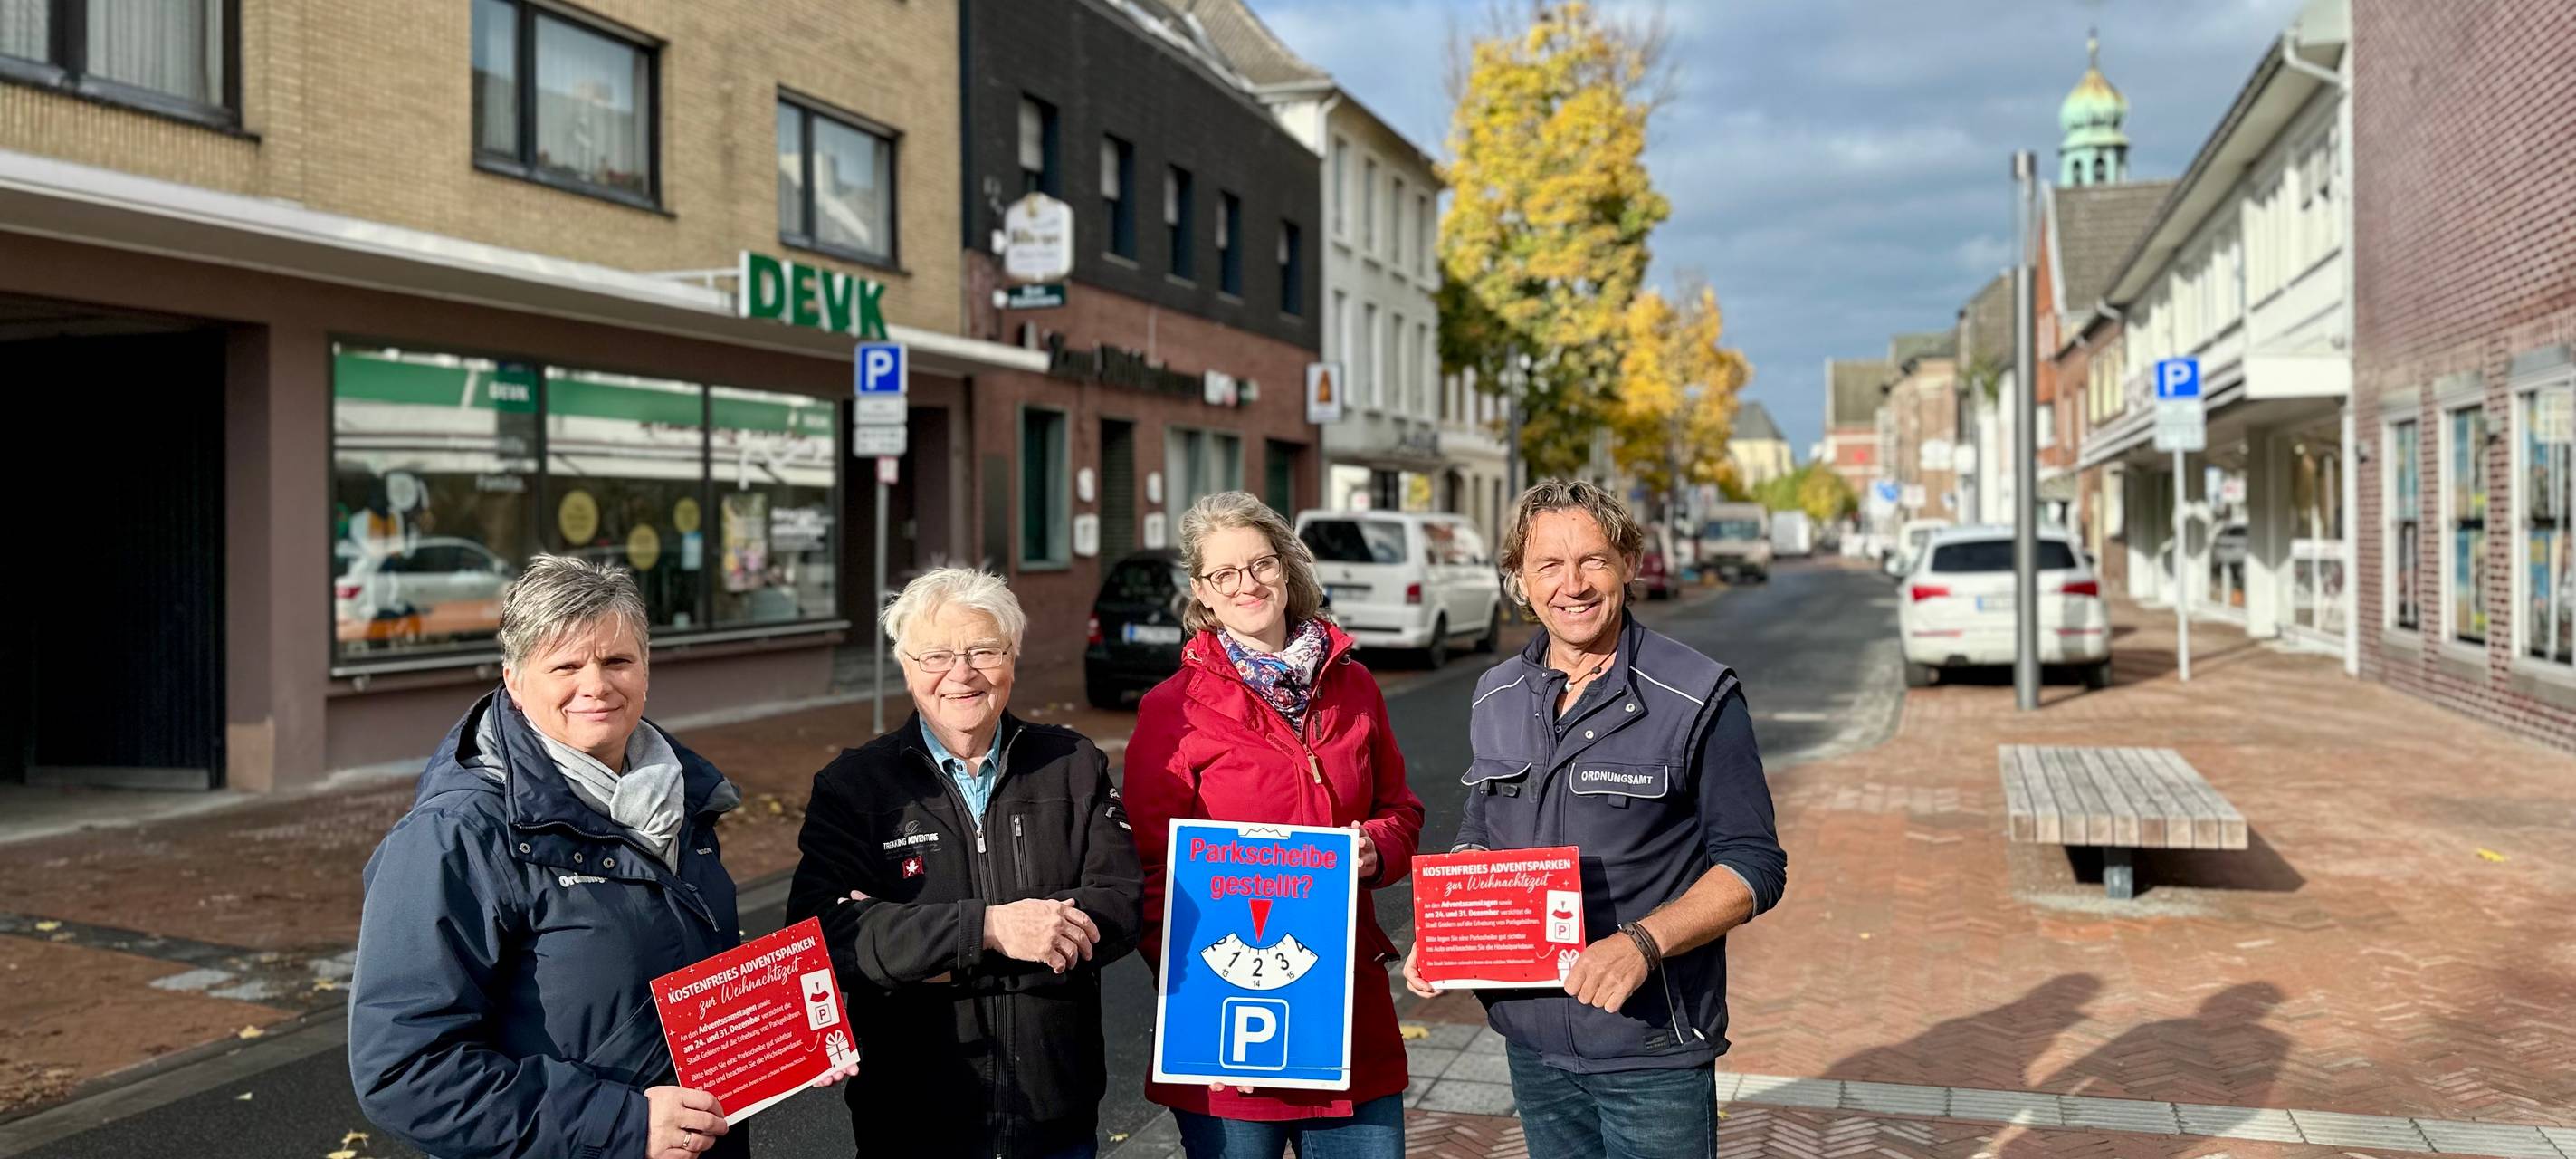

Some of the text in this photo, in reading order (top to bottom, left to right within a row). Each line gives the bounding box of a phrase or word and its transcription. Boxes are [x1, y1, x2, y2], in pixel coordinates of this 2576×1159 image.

[740, 251, 888, 341] DEVK
[866, 350, 894, 391] P
[2164, 362, 2192, 396] P
[489, 380, 529, 401] DEVK
[1580, 771, 1653, 784] ORDNUNGSAMT
[883, 832, 939, 850] TREKKING ADVENTURE
[1189, 837, 1338, 869] Parkscheibe
[1422, 858, 1570, 876] KOSTENFREIES ADVENTSPARKEN
[1209, 873, 1314, 900] gestellt?
[1444, 871, 1555, 896] zur Weihnachtszeit
[1440, 899, 1498, 907] Adventssamstagen
[1468, 908, 1499, 916] Dezember
[1558, 924, 1566, 936] P
[667, 935, 815, 1003] KOSTENFREIES ADVENTSPARKEN
[1227, 951, 1290, 977] 1 2 3
[698, 955, 803, 1020] zur Weihnachtszeit
[1221, 968, 1296, 988] 13 14 15
[698, 1004, 757, 1034] Adventssamstagen
[817, 1006, 828, 1021] P
[682, 1044, 694, 1053] am
[693, 1038, 706, 1048] 24.
[705, 1030, 719, 1043] und
[719, 1028, 730, 1038] 31.
[729, 1014, 760, 1032] Dezember
[1232, 1005, 1277, 1062] P
